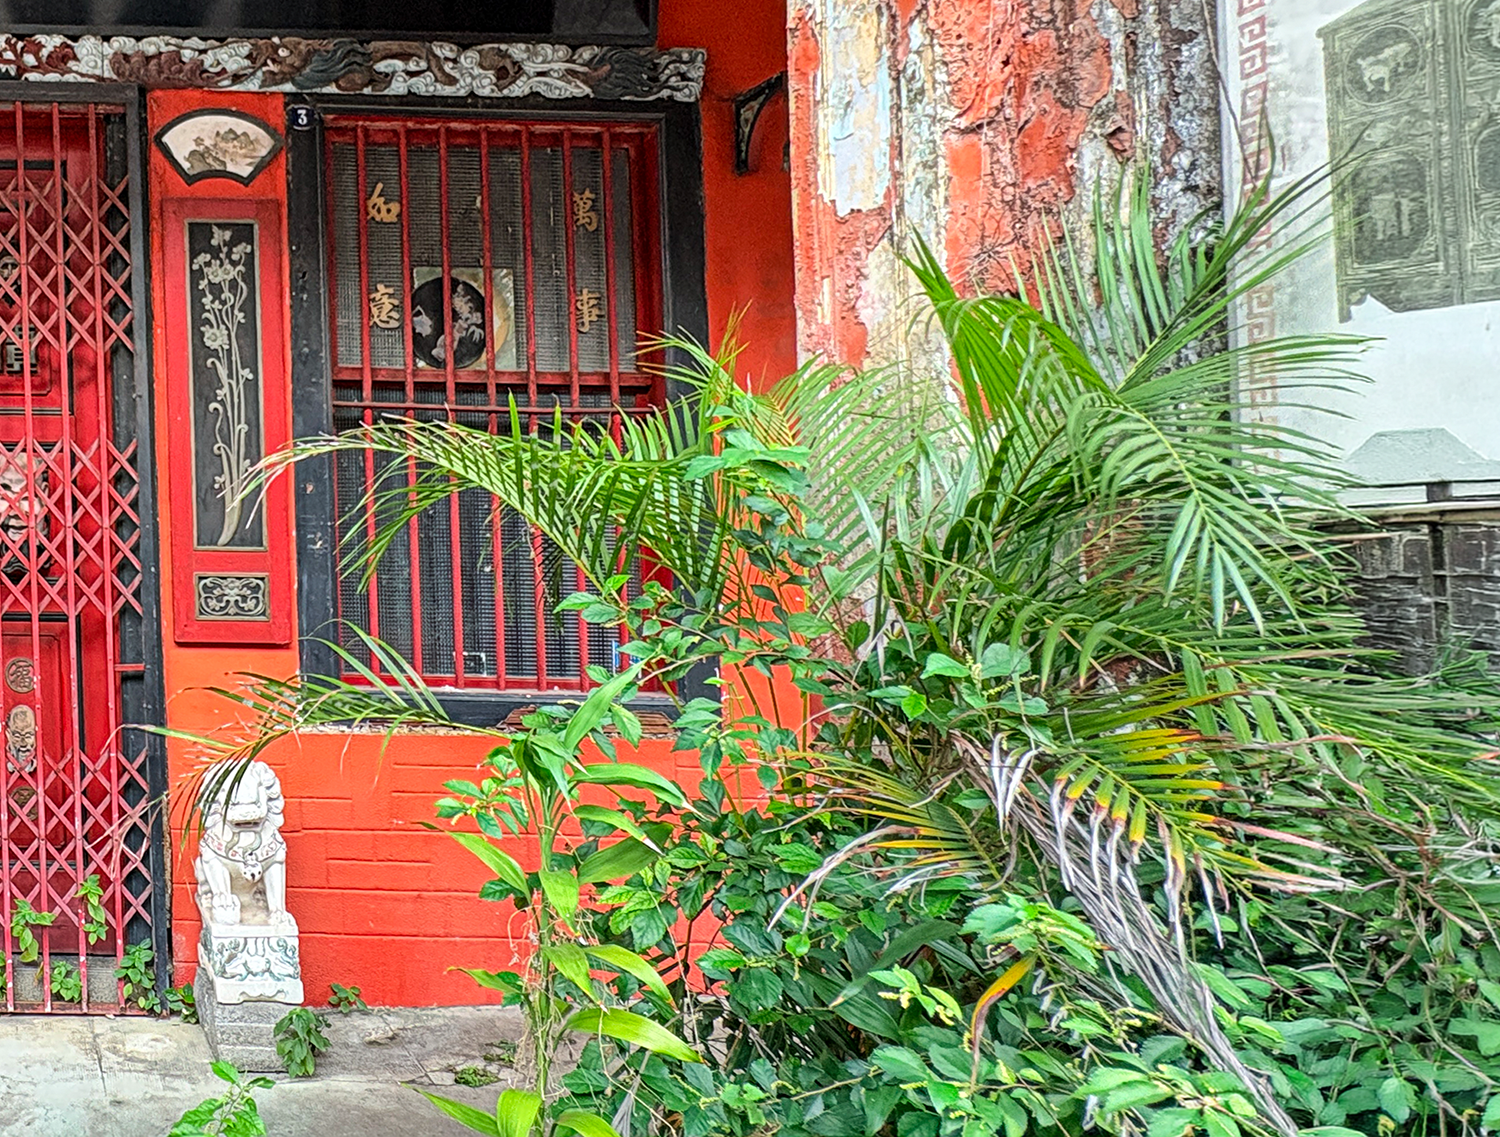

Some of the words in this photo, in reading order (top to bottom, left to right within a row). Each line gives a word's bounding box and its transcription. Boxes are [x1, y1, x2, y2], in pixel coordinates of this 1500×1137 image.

[297, 109, 308, 125] 3
[366, 182, 401, 330] 如意
[573, 188, 602, 333] 萬事
